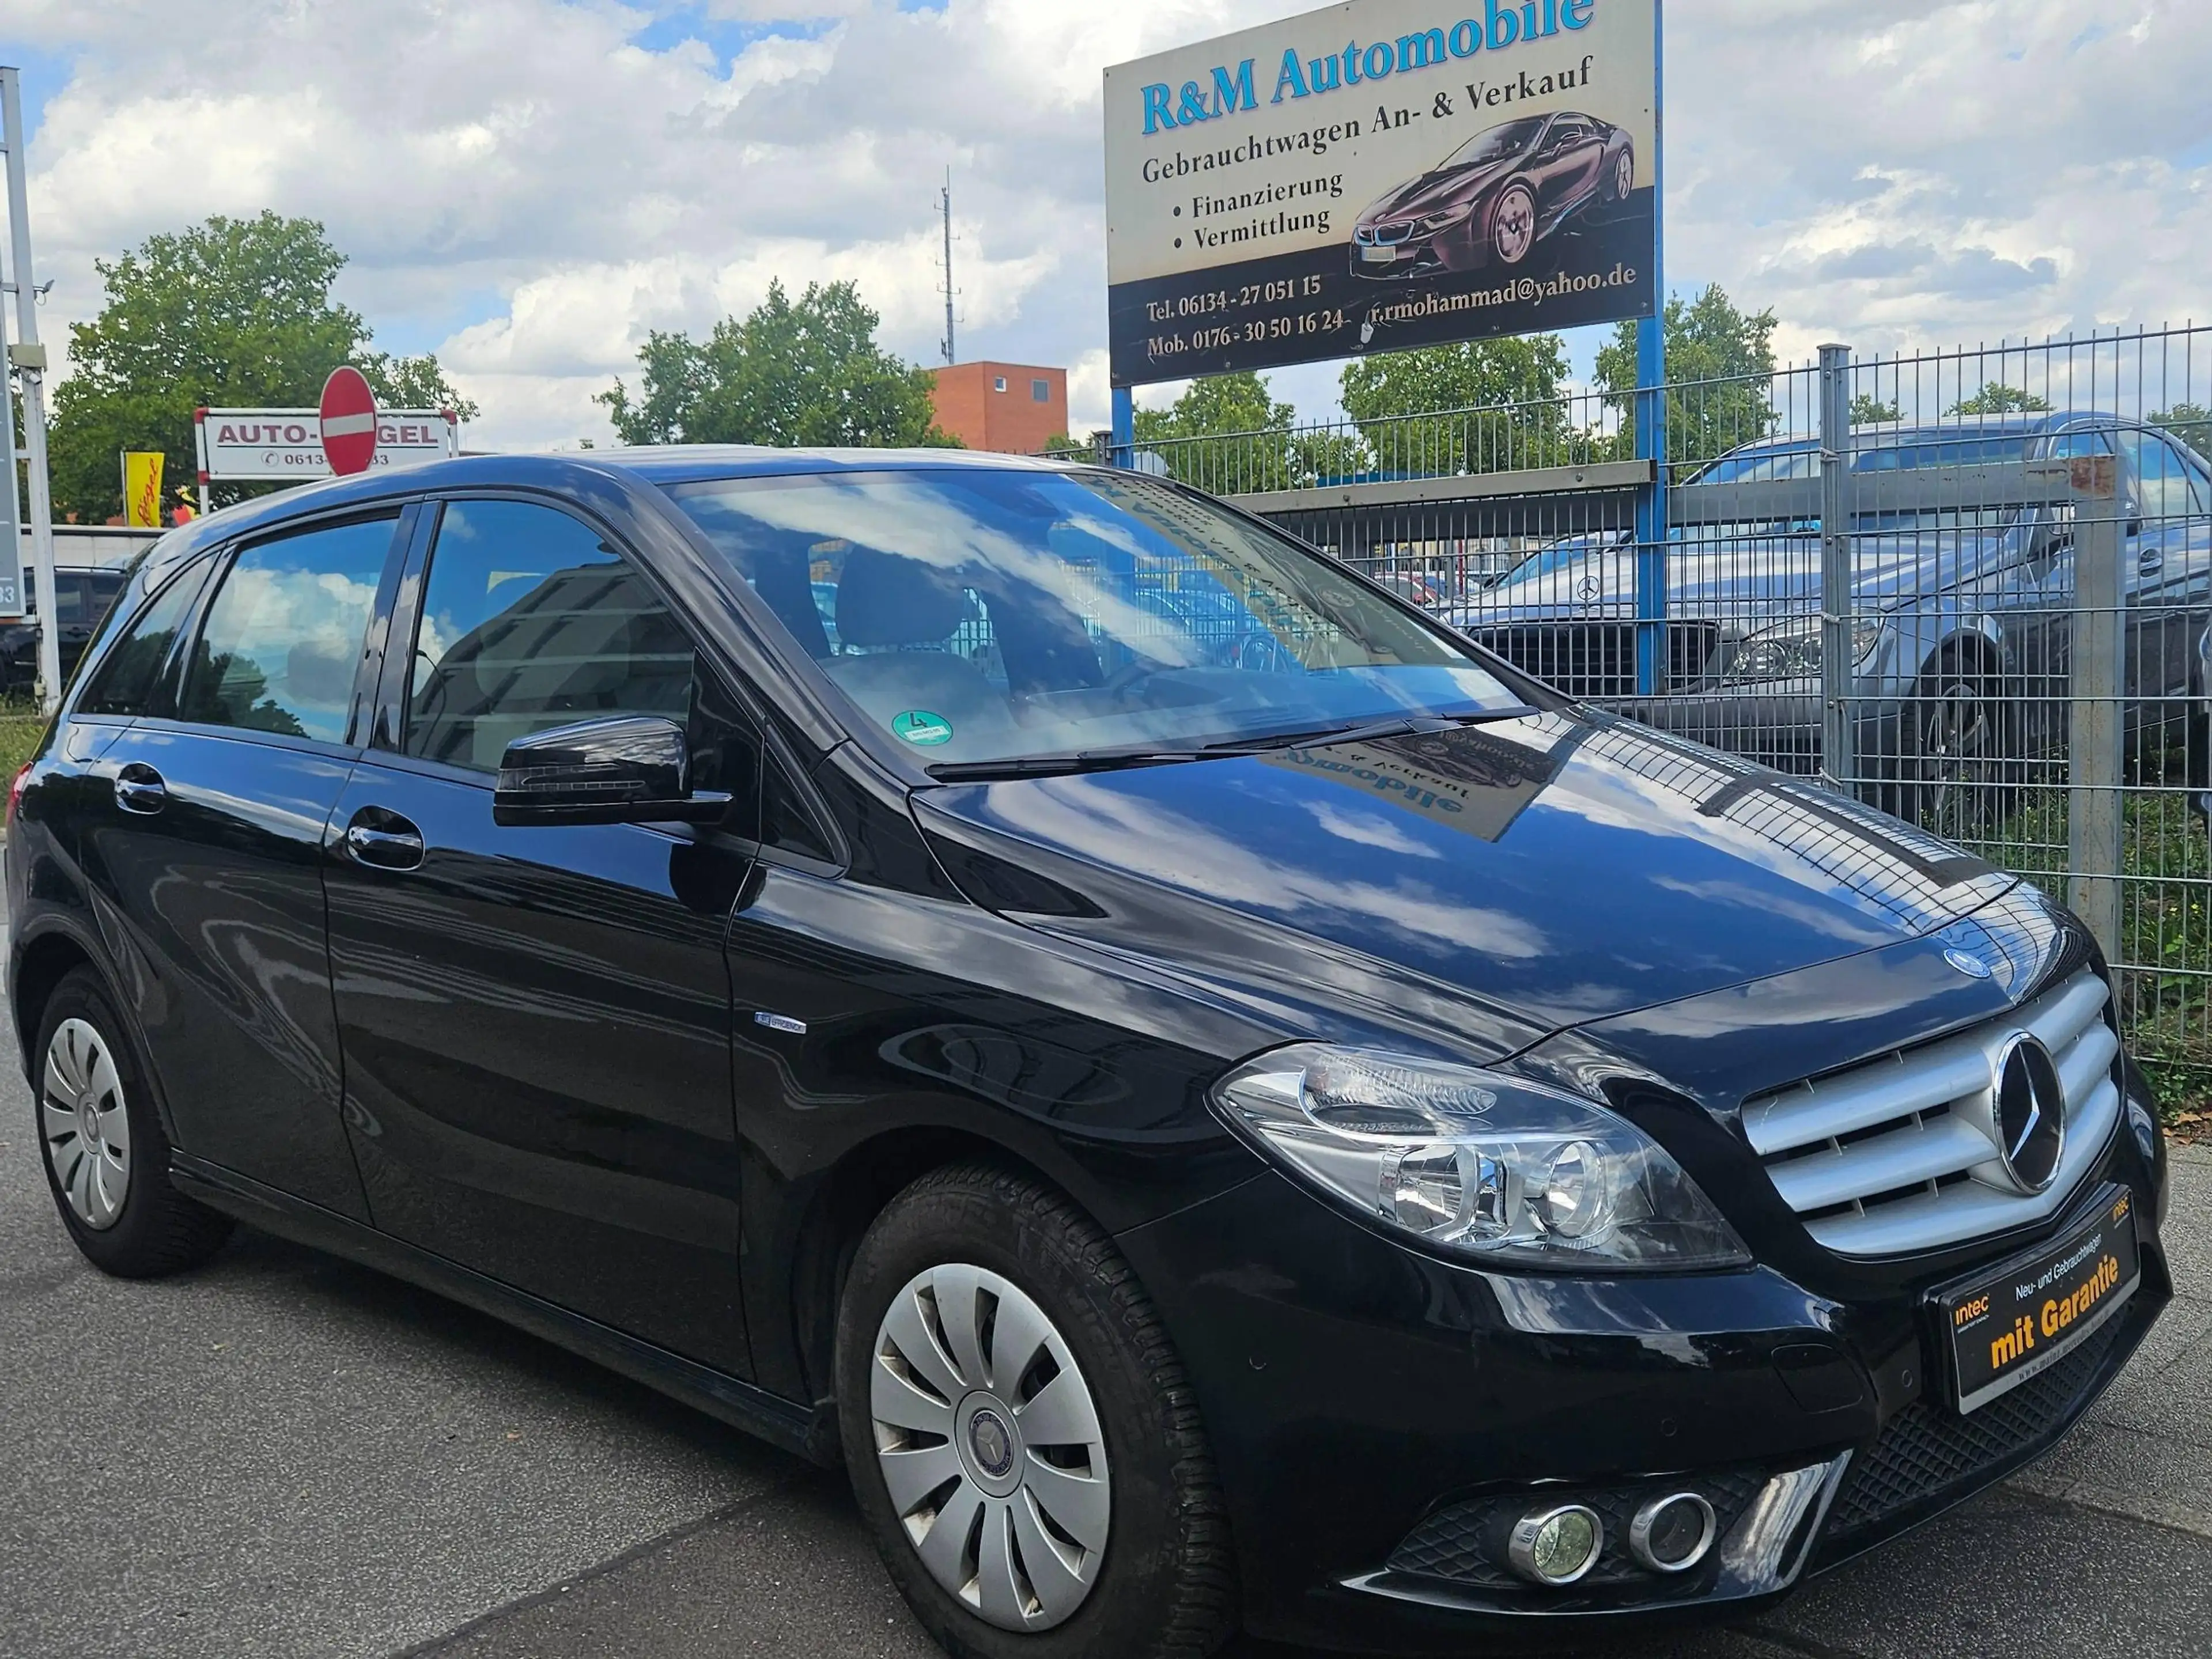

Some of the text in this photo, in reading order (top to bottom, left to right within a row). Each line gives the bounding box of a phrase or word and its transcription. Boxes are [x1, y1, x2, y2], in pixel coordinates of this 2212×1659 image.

[1140, 0, 1594, 135] R&M Automobile
[1143, 55, 1594, 183] Gebrauchtwagen An- & Verkauf
[1193, 174, 1343, 218] Finanzierung
[1194, 211, 1330, 249] Vermittlung
[1147, 300, 1174, 322] Tel.
[1179, 291, 1227, 316] 06134
[1241, 285, 1260, 306] 27
[1265, 280, 1294, 302] 051
[1303, 275, 1321, 296] 15
[1370, 263, 1636, 323] r.rmohammad@yahoo.de
[1148, 333, 1188, 357] Mob.
[1193, 327, 1230, 350] 0176
[1244, 321, 1265, 341] 30
[1270, 317, 1291, 338] 50
[1298, 313, 1316, 334] 16
[1322, 309, 1344, 330] 24
[909, 713, 928, 728] 4
[2015, 1233, 2102, 1301] Neu- und Gebrauchtwagen
[1991, 1314, 2035, 1369] mit
[2041, 1254, 2119, 1338] Garantie
